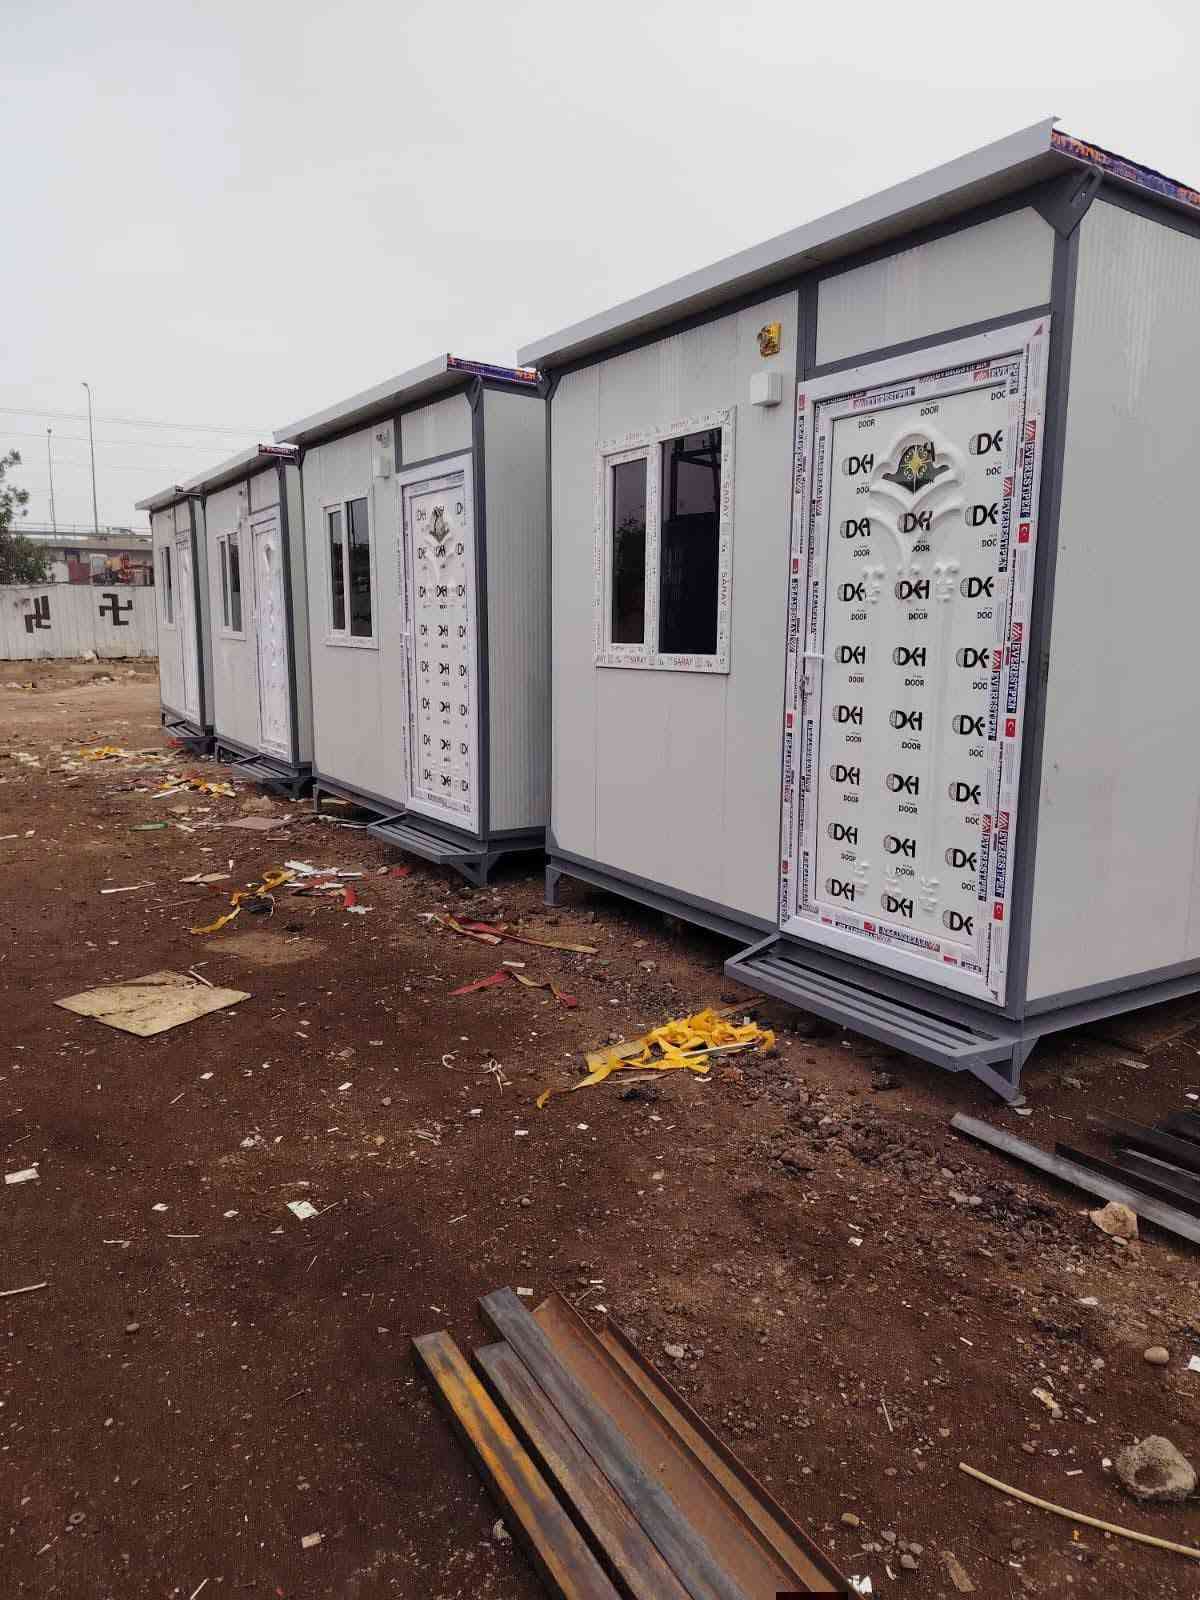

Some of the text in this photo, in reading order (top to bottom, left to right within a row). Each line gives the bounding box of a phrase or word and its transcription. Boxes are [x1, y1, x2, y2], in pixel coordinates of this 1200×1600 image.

[920, 405, 939, 416] DOOR
[1021, 441, 1036, 514] EVERESTPEN
[720, 572, 728, 606] SARAY
[1008, 643, 1021, 710] EVERESTPEN
[989, 671, 1000, 737] EVERESTPEN
[846, 735, 862, 743] DOOR
[902, 742, 921, 750] DOOR
[844, 795, 859, 803] DOOR
[898, 805, 918, 814] DOOR
[995, 832, 1008, 893] EVERESTPEN
[896, 867, 915, 876] DOOR
